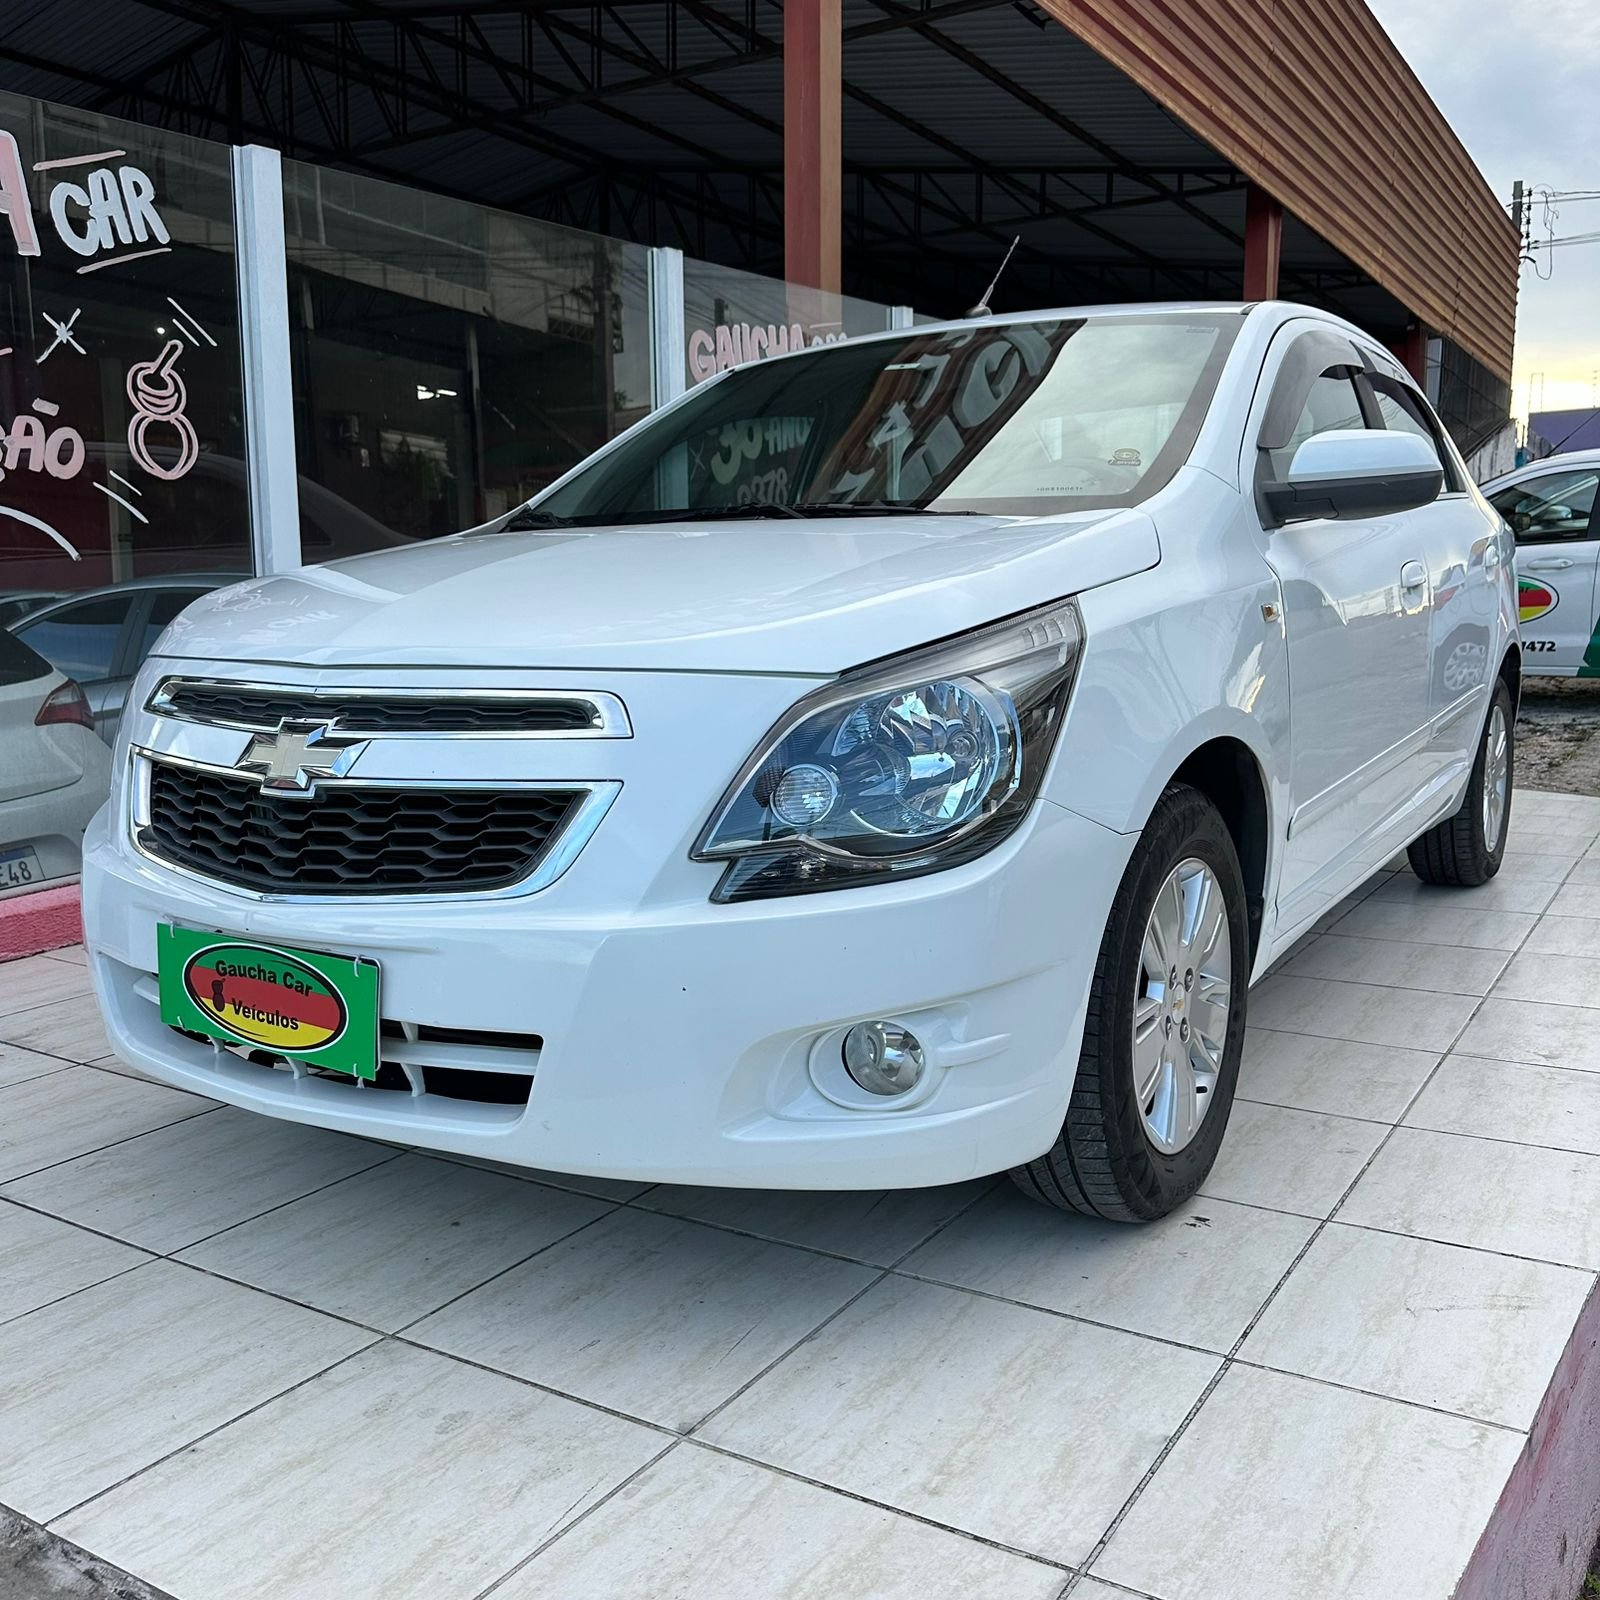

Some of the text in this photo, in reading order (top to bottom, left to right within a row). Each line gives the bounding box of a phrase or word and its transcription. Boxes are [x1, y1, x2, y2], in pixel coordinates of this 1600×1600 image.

[50, 165, 171, 257] CAR
[0, 398, 86, 482] ÃO
[215, 960, 313, 997] Gaucha Car
[231, 998, 299, 1031] Veículos
